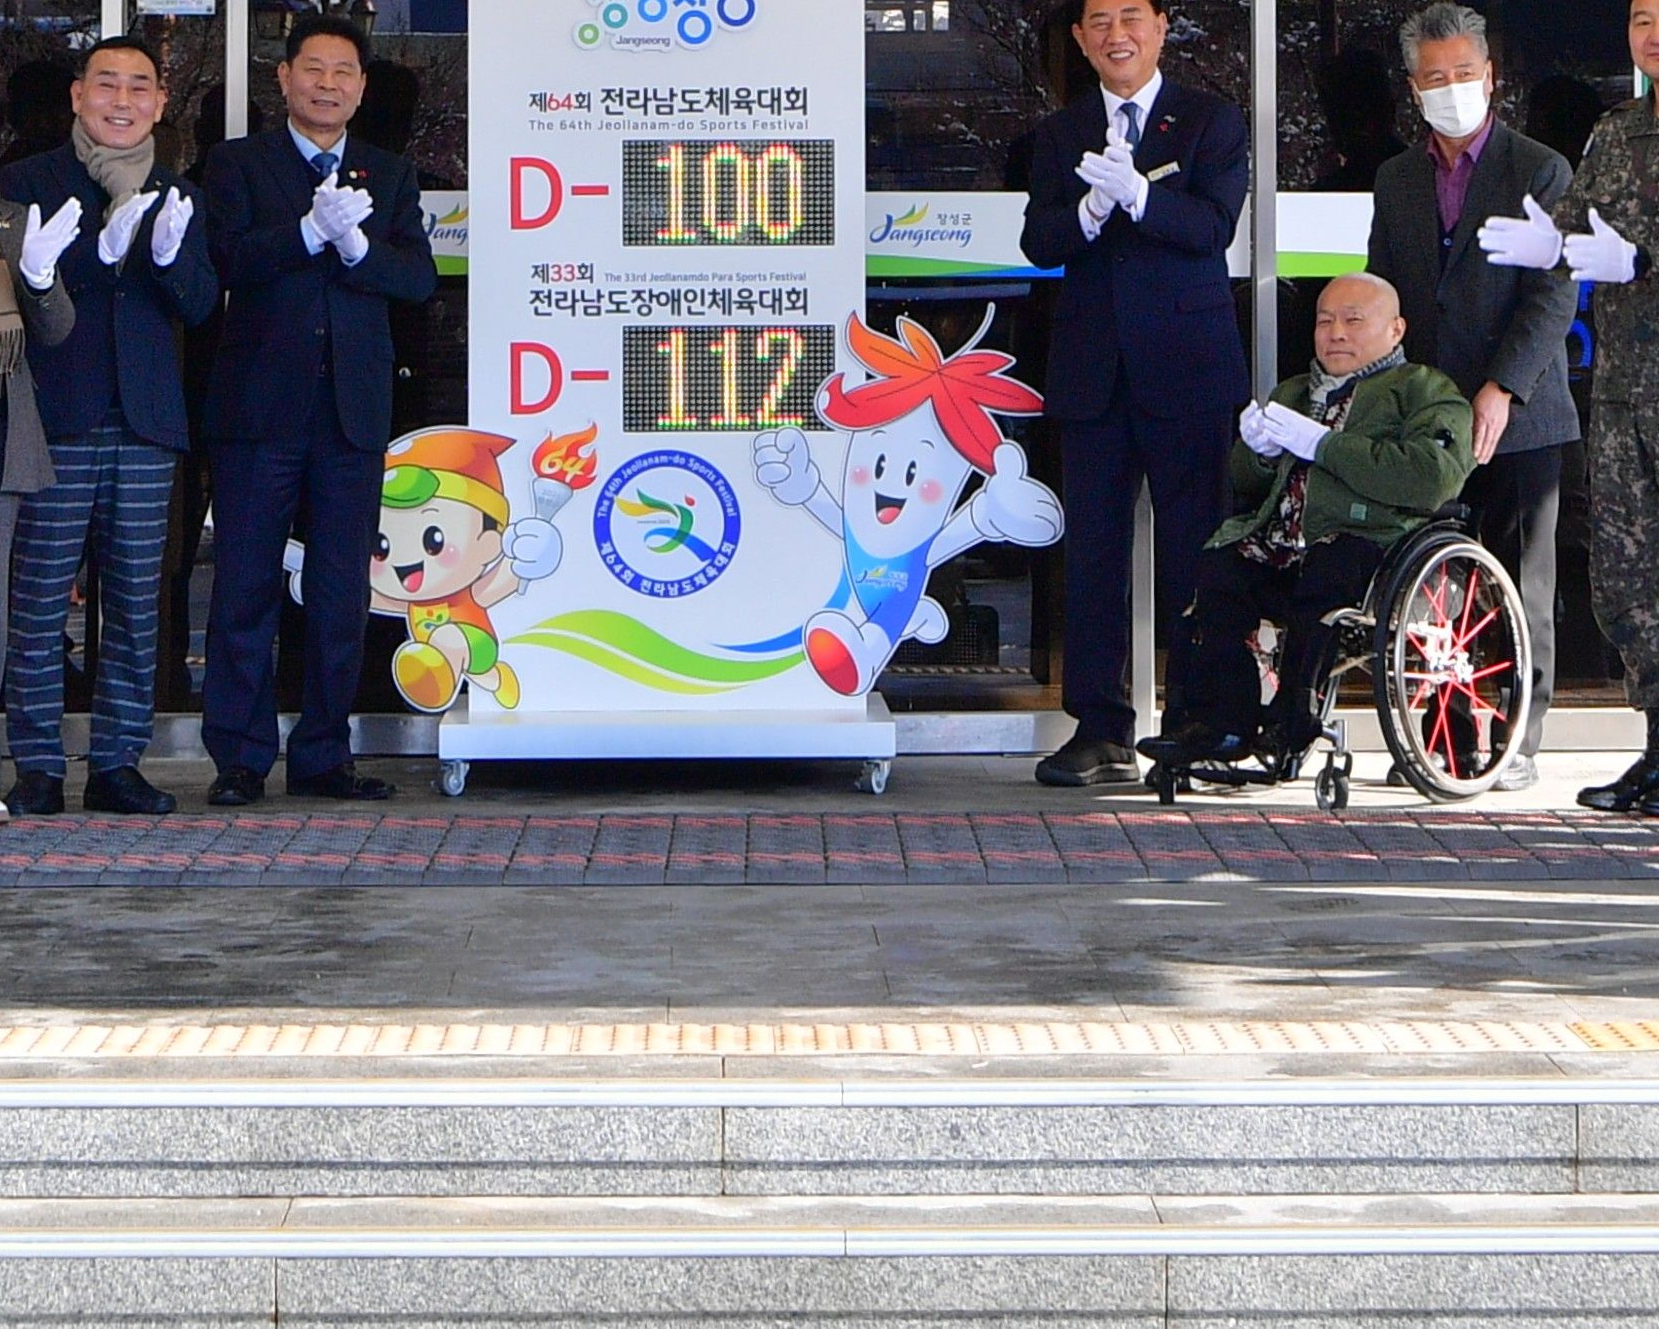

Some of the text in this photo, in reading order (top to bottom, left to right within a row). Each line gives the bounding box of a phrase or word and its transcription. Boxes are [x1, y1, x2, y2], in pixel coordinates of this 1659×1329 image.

[616, 36, 671, 47] Jangseong
[529, 87, 807, 116] 제64회 전라남도체육대회
[529, 119, 808, 132] The 64th Jeollanam-do Sports Festival
[510, 143, 803, 241] D- 100
[869, 213, 973, 248] Jangseong
[531, 263, 593, 285] 제33회
[604, 272, 807, 283] The 33rd Jeollanamdo Para Sports Festival
[529, 287, 808, 317] 전라남도장애인체육대회
[510, 327, 804, 427] D- 112
[540, 445, 588, 484] 64
[687, 456, 717, 481] Sports
[714, 480, 738, 517] Festival
[640, 542, 736, 597] 전라남도체육대회
